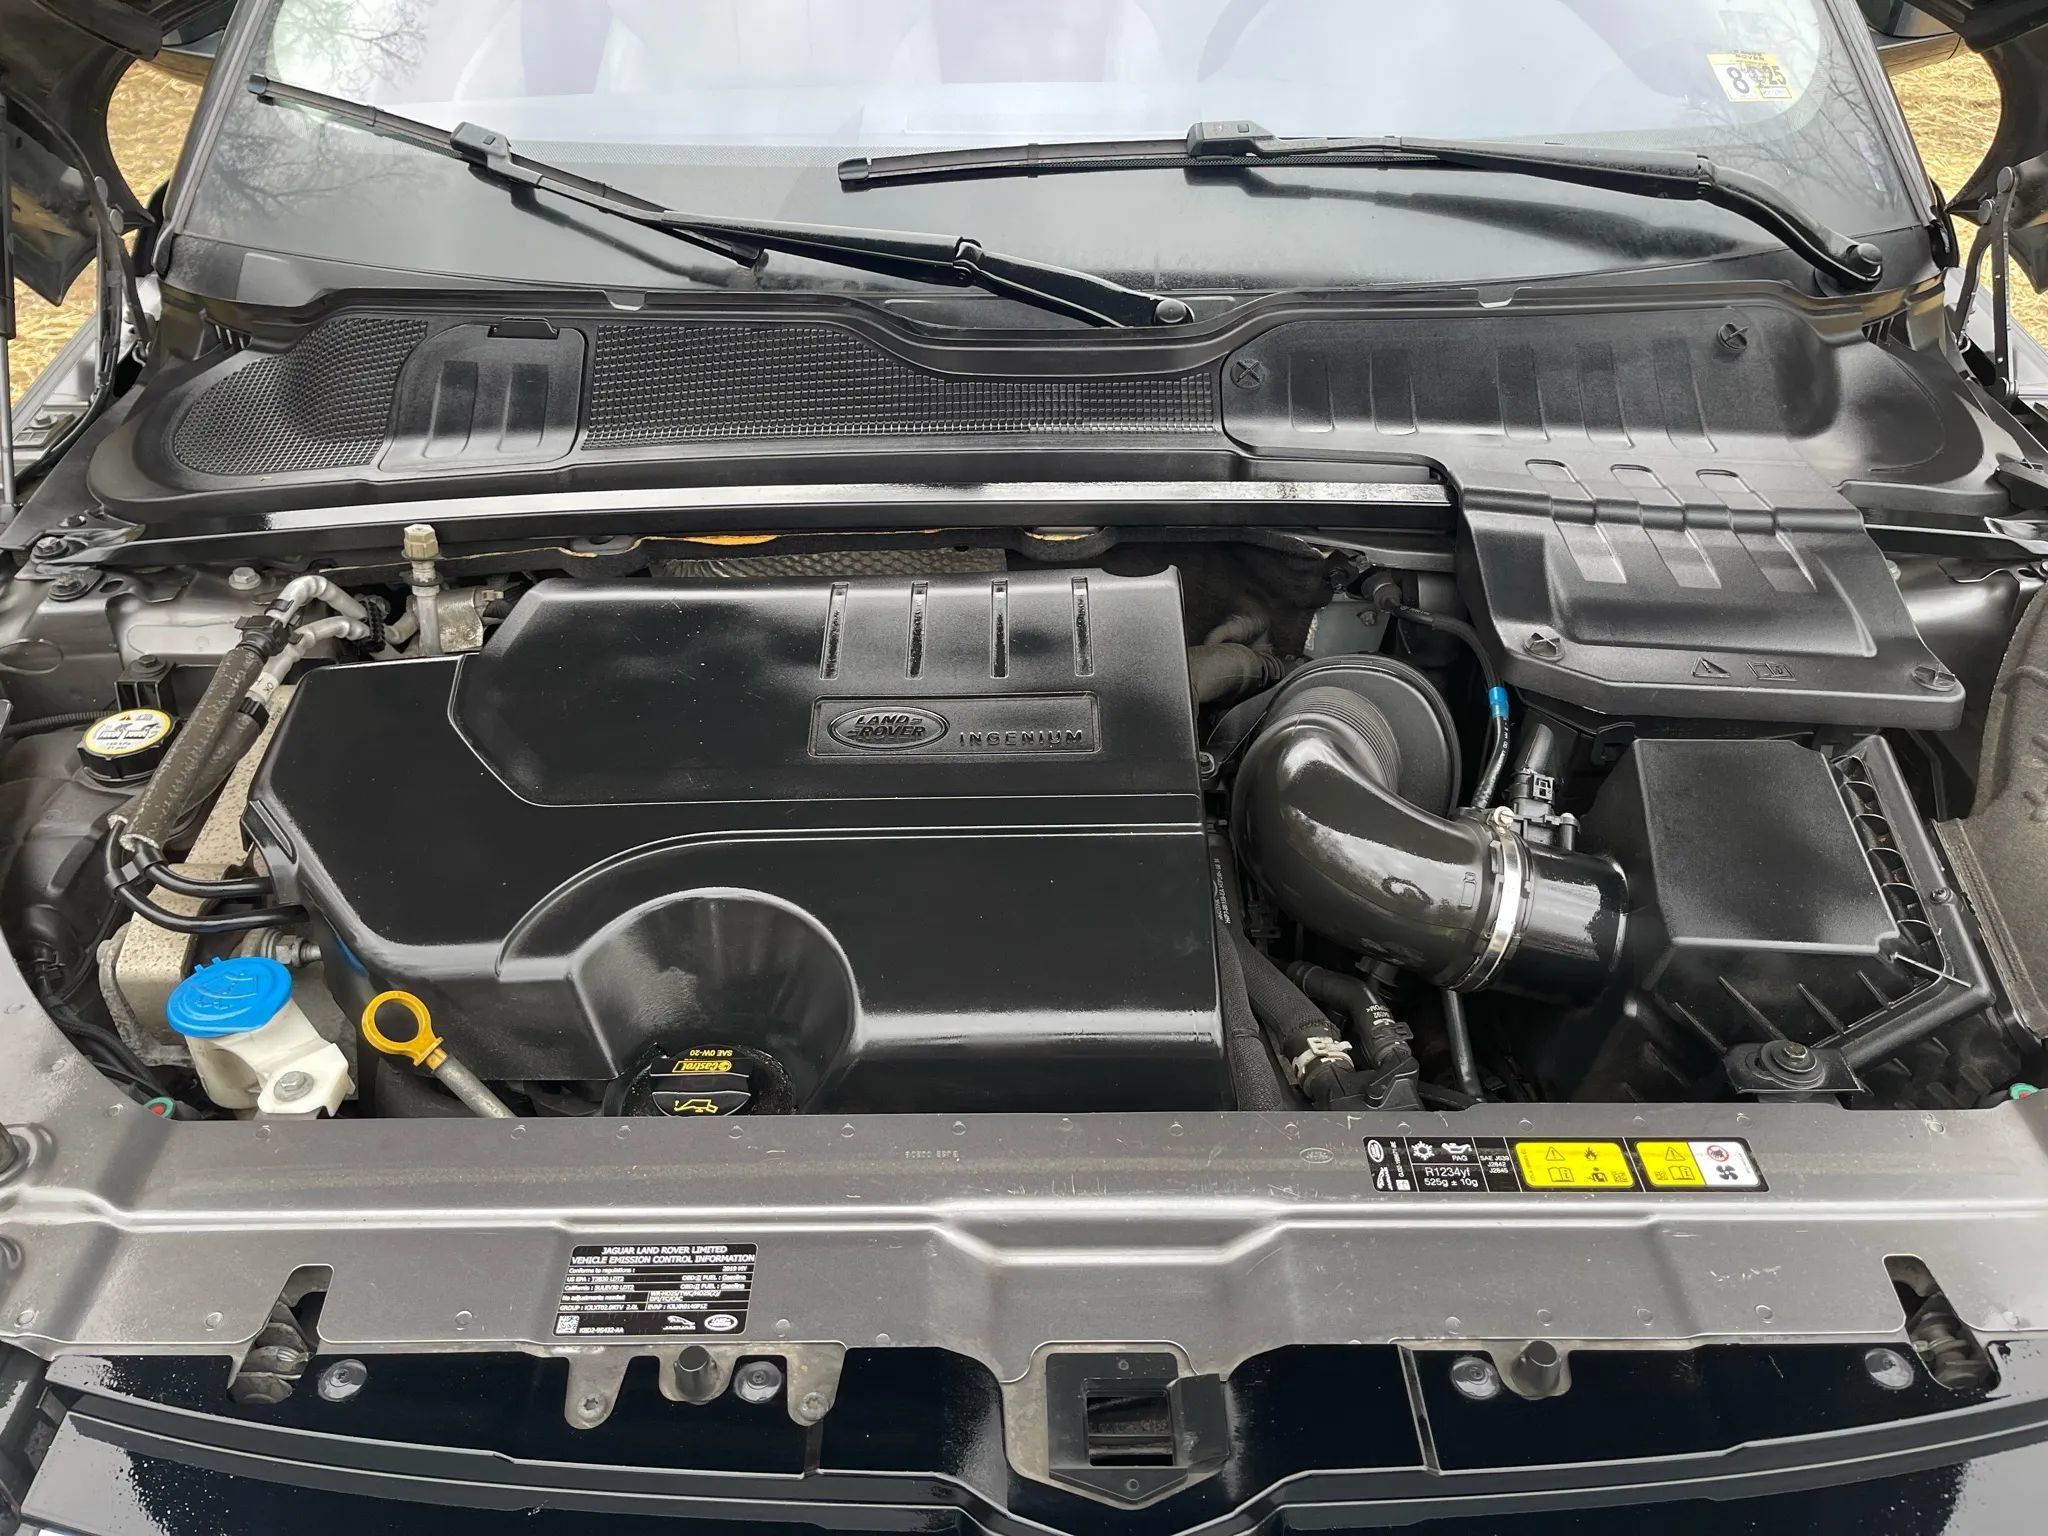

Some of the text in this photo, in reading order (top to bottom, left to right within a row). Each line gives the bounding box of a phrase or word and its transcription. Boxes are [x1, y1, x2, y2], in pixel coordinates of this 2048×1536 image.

[1726, 66, 1750, 94] 8
[855, 715, 909, 726] LAND
[858, 726, 926, 738] ROVER
[959, 730, 1083, 746] INGENIUM
[682, 1062, 718, 1070] Castrol
[1425, 1167, 1470, 1178] R1234yf
[1424, 1178, 1448, 1187] 525g
[1460, 1178, 1478, 1187] 10g
[601, 1246, 635, 1255] JAGUAR
[636, 1246, 660, 1254] LAND
[572, 1254, 755, 1264] VEHICLE EMISSION CONTROL INFORMATION
